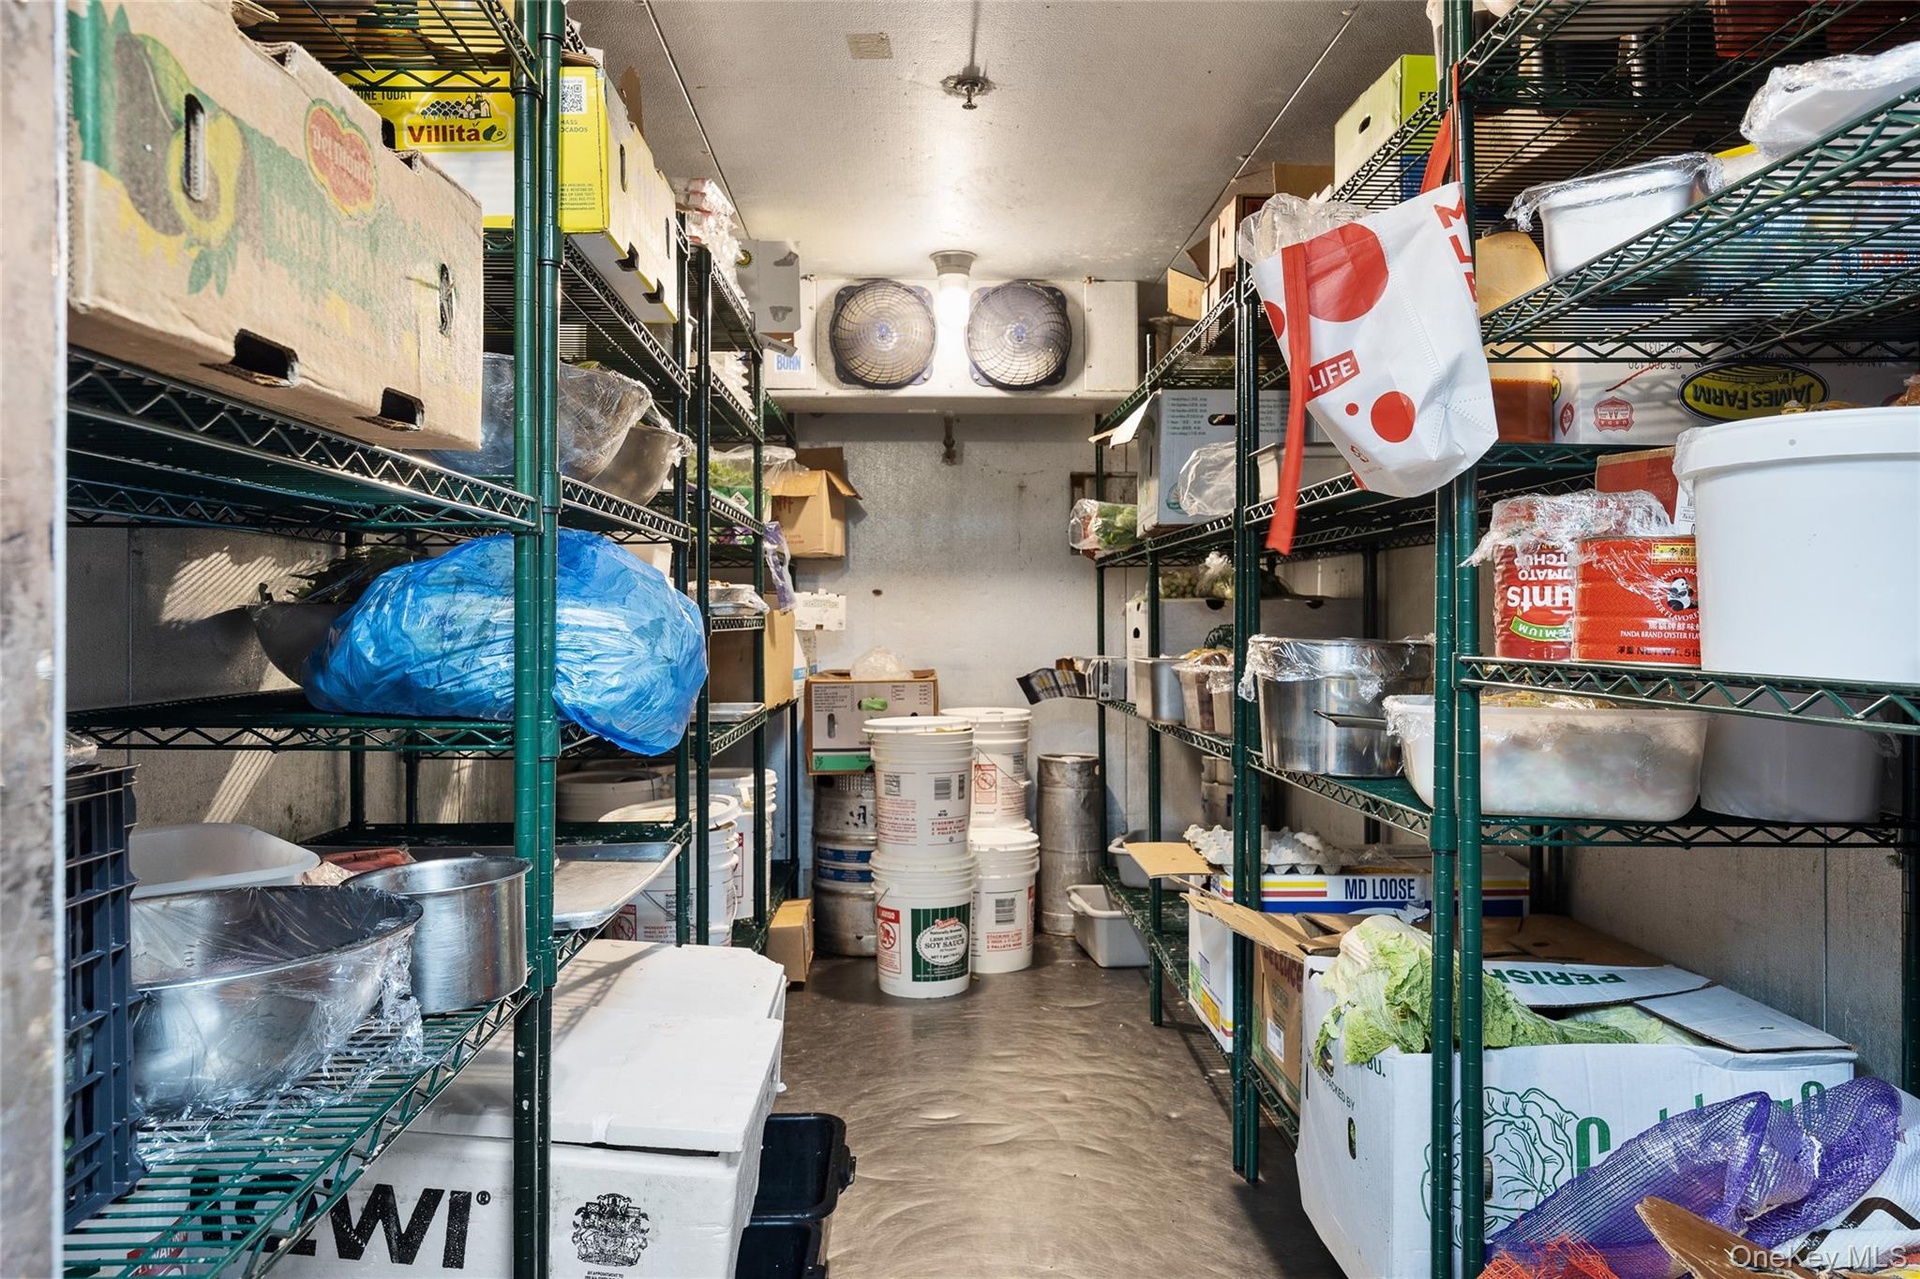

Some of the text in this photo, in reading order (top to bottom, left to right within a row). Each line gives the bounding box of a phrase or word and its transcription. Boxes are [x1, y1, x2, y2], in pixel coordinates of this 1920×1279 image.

[381, 91, 412, 100] TODAY
[1308, 357, 1356, 392] LIFE
[1692, 381, 1815, 411] JAMES FARM
[1664, 631, 1687, 639] OYSTER
[1344, 878, 1415, 900] MD LOOSE
[942, 937, 965, 948] SAUCE
